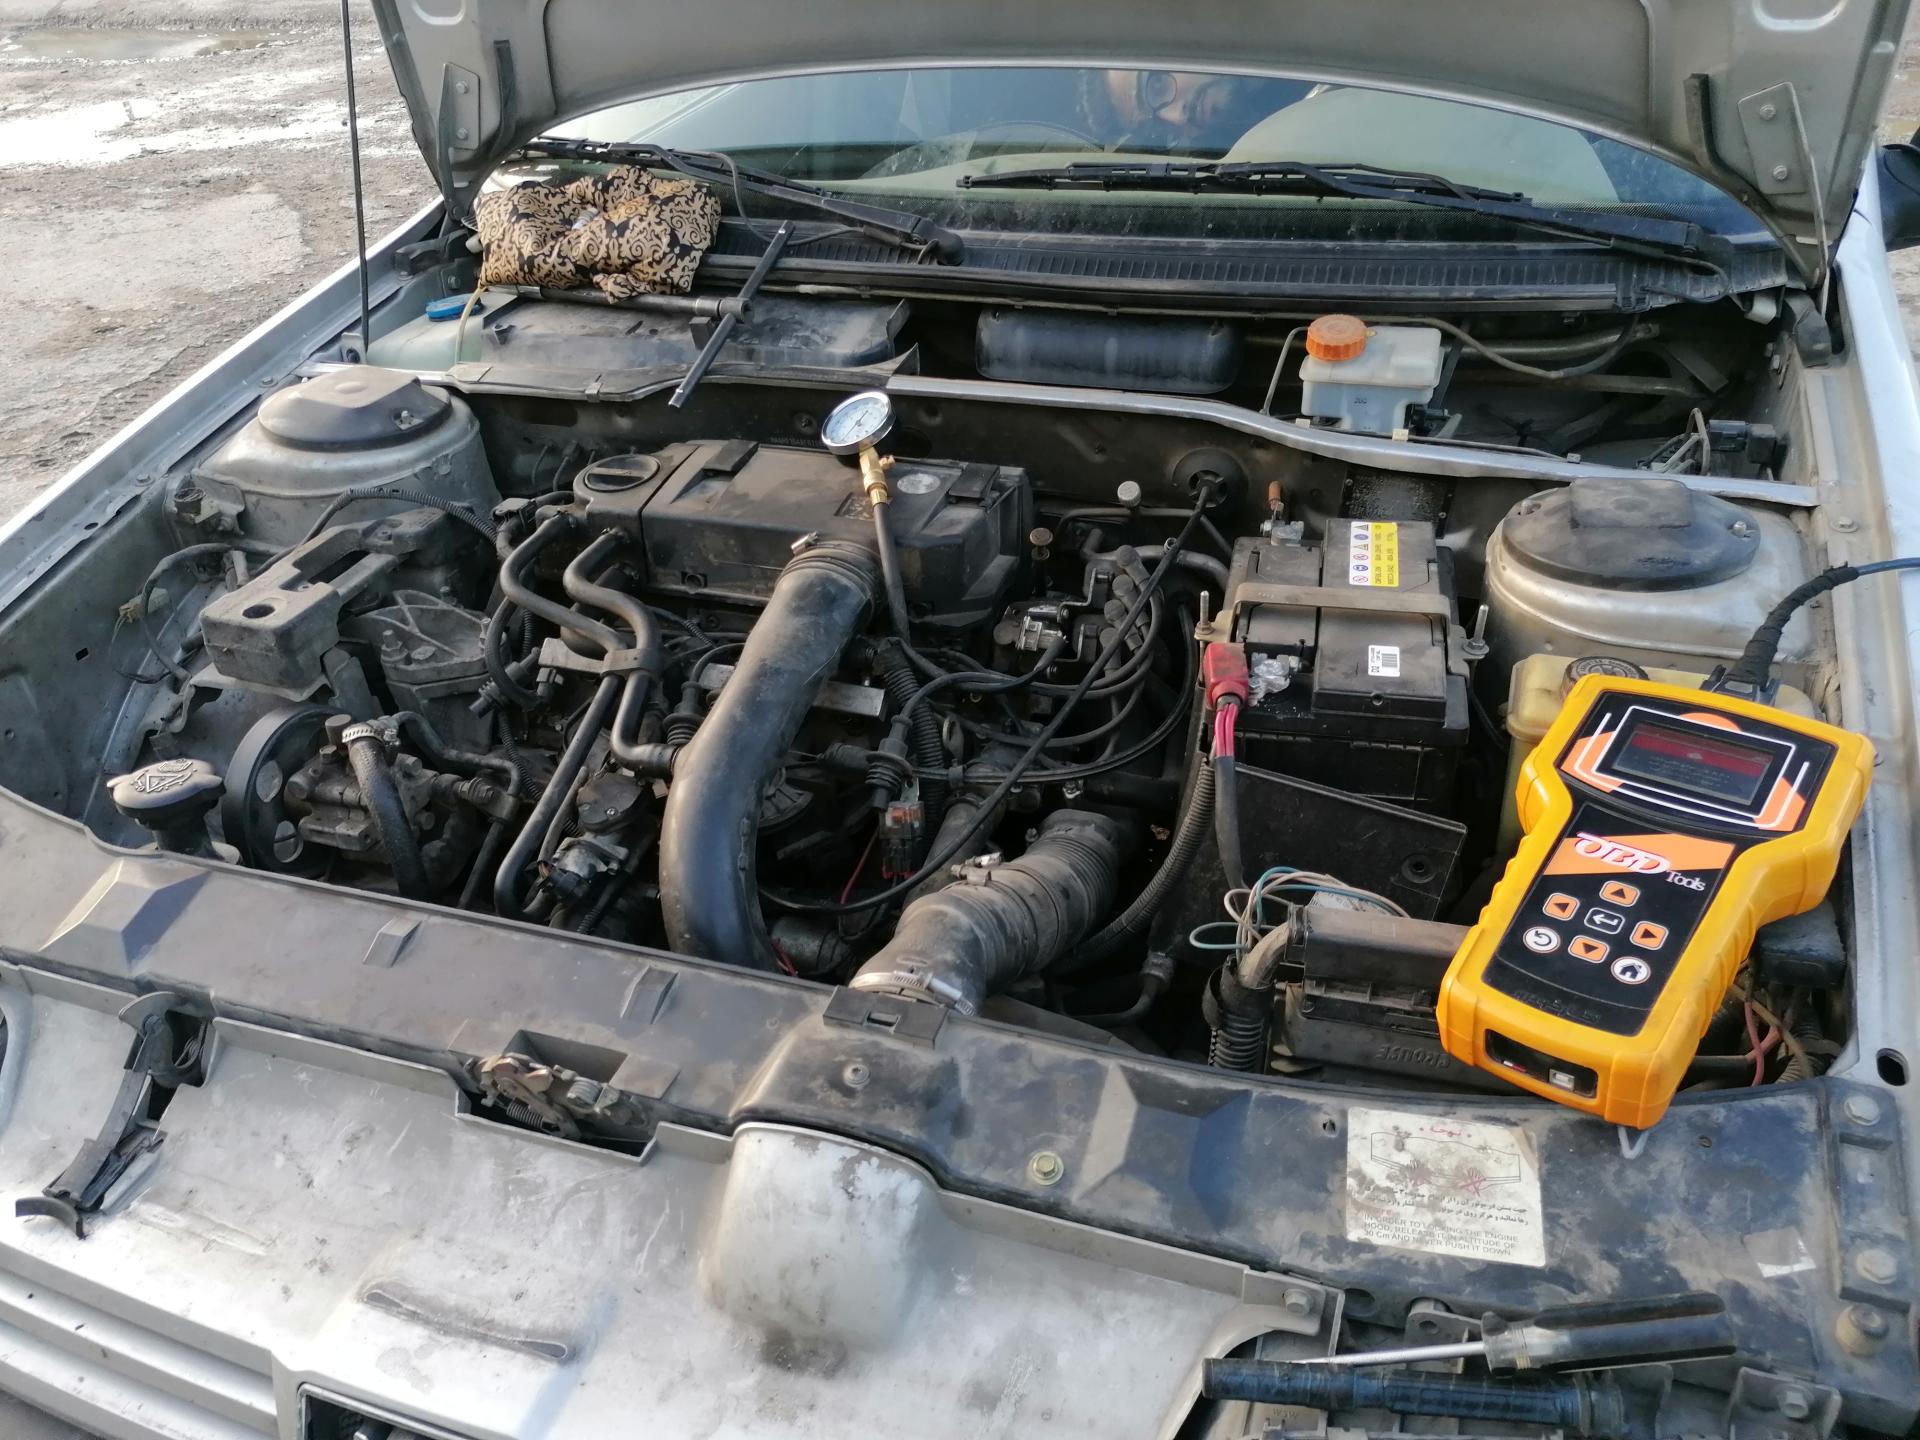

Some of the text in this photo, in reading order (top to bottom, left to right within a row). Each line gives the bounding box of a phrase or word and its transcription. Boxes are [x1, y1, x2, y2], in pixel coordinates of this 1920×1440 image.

[1575, 831, 1671, 874] OBD
[1664, 869, 1706, 891] Tools
[1410, 1220, 1421, 1228] TO
[1391, 1232, 1410, 1241] AND
[1445, 1240, 1470, 1250] PUSH
